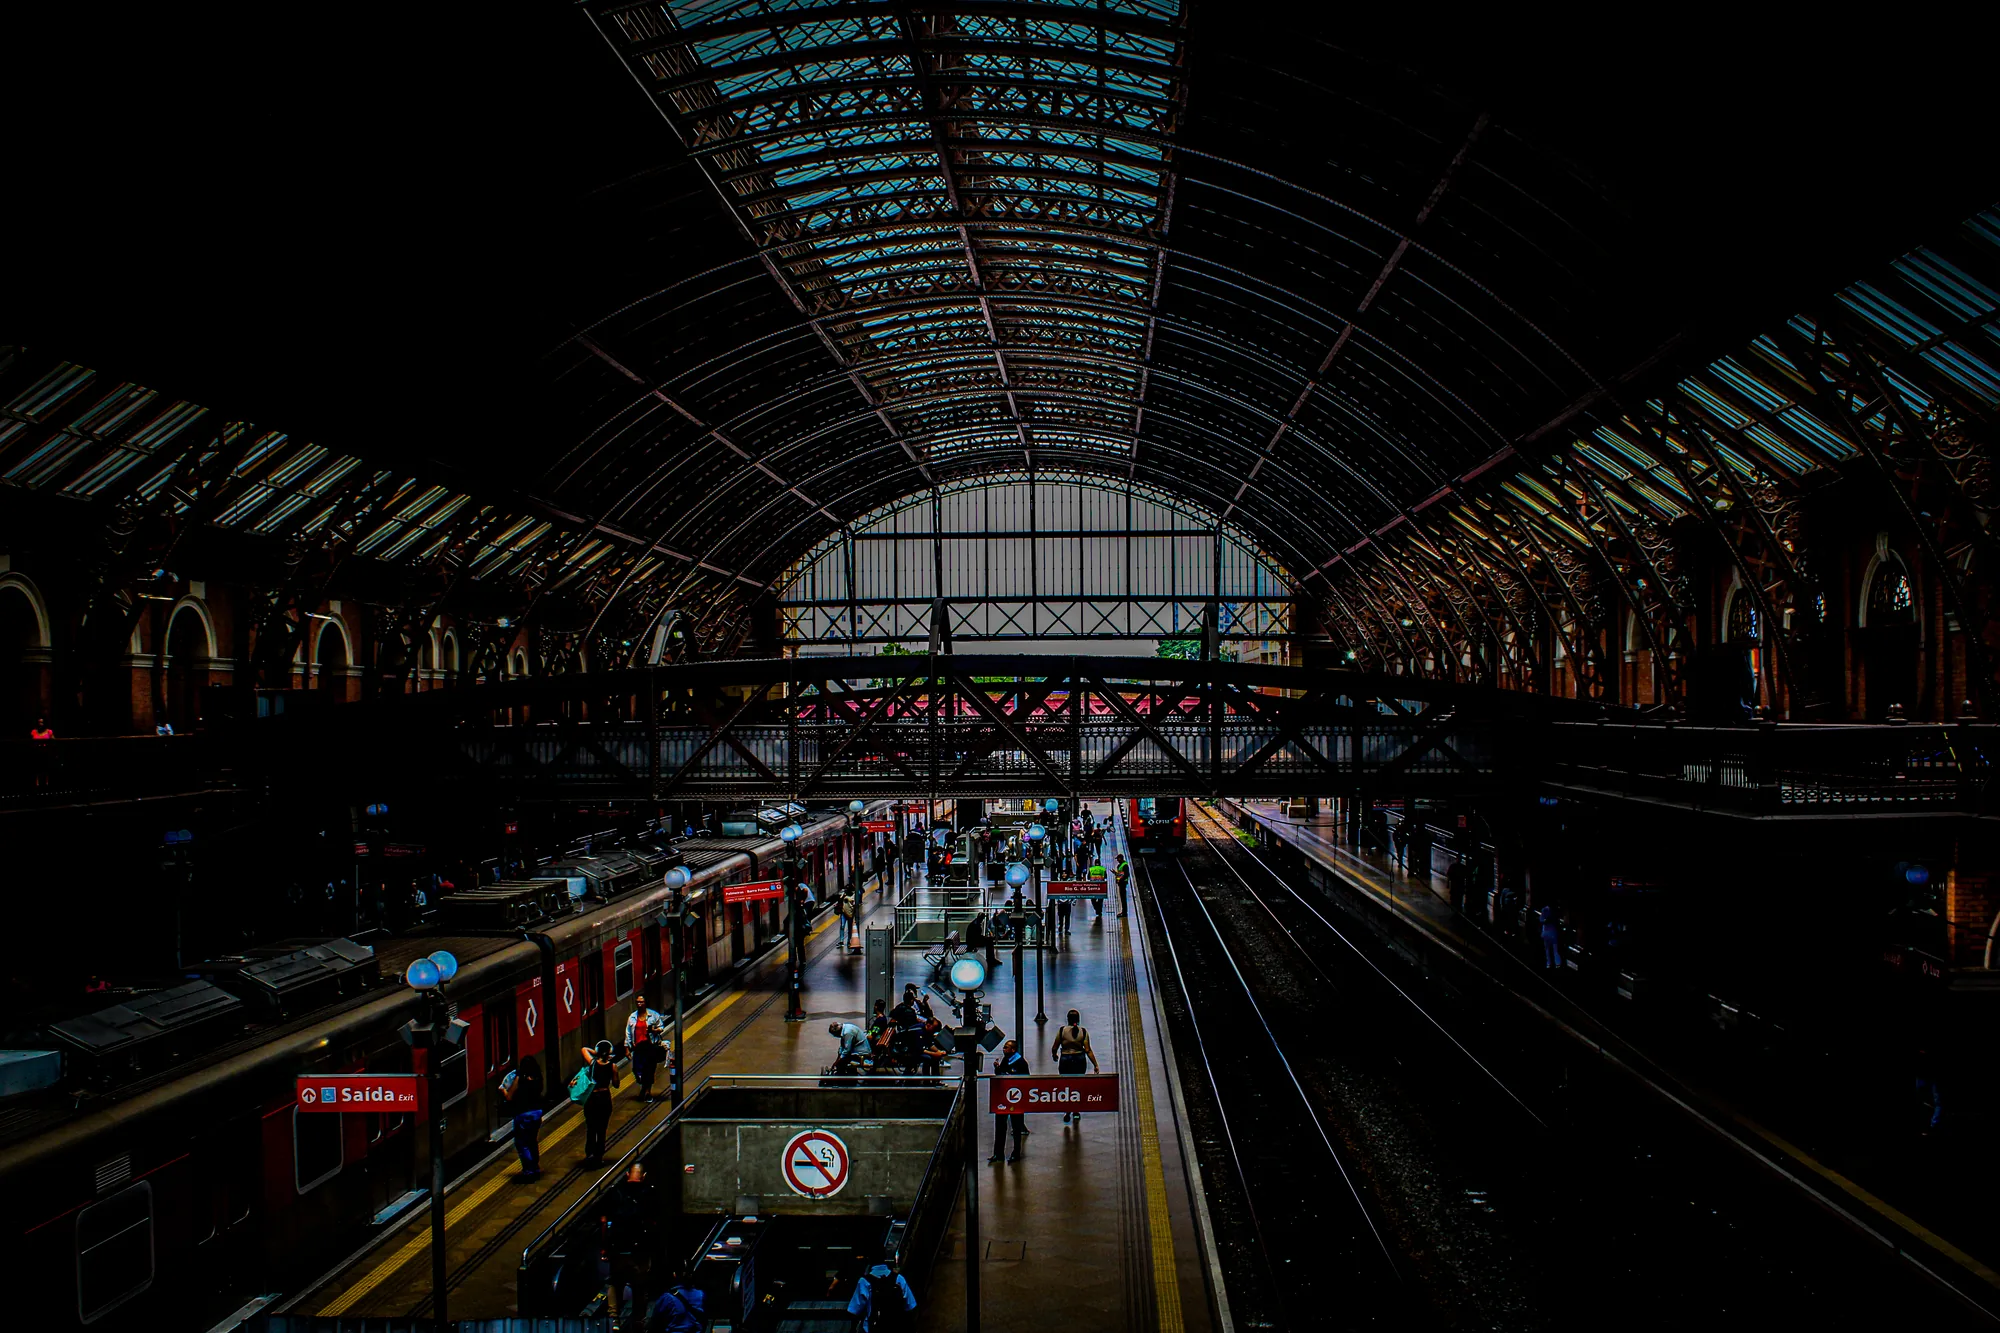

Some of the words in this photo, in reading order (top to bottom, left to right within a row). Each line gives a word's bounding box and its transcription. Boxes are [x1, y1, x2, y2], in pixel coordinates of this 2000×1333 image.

[341, 1086, 395, 1102] Saída
[398, 1093, 415, 1102] Exit
[1028, 1087, 1081, 1103] Saída
[1087, 1094, 1103, 1102] Exit
